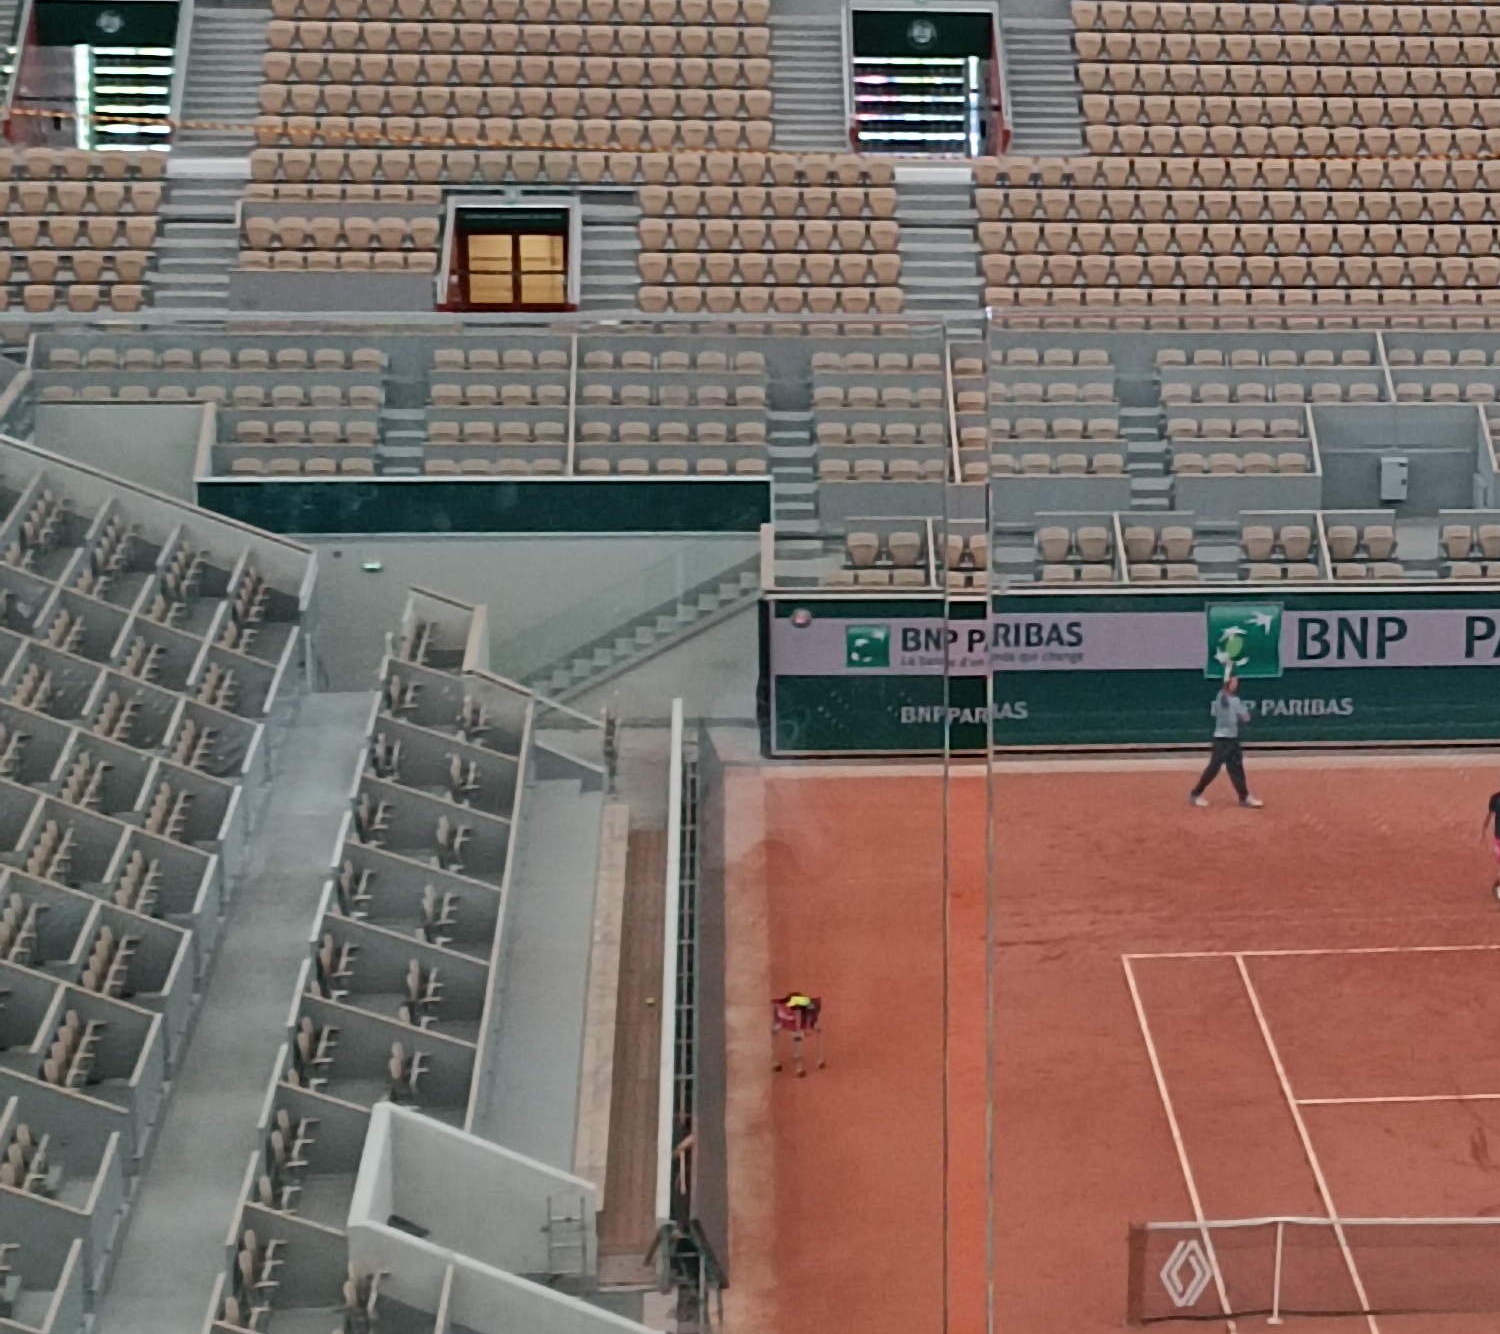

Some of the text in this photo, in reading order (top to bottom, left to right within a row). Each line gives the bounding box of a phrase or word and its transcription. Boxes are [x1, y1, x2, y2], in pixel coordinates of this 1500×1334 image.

[901, 621, 1084, 654] BNP PRIBAS
[1296, 616, 1408, 661] BNP
[1261, 697, 1354, 717] PARIBAS
